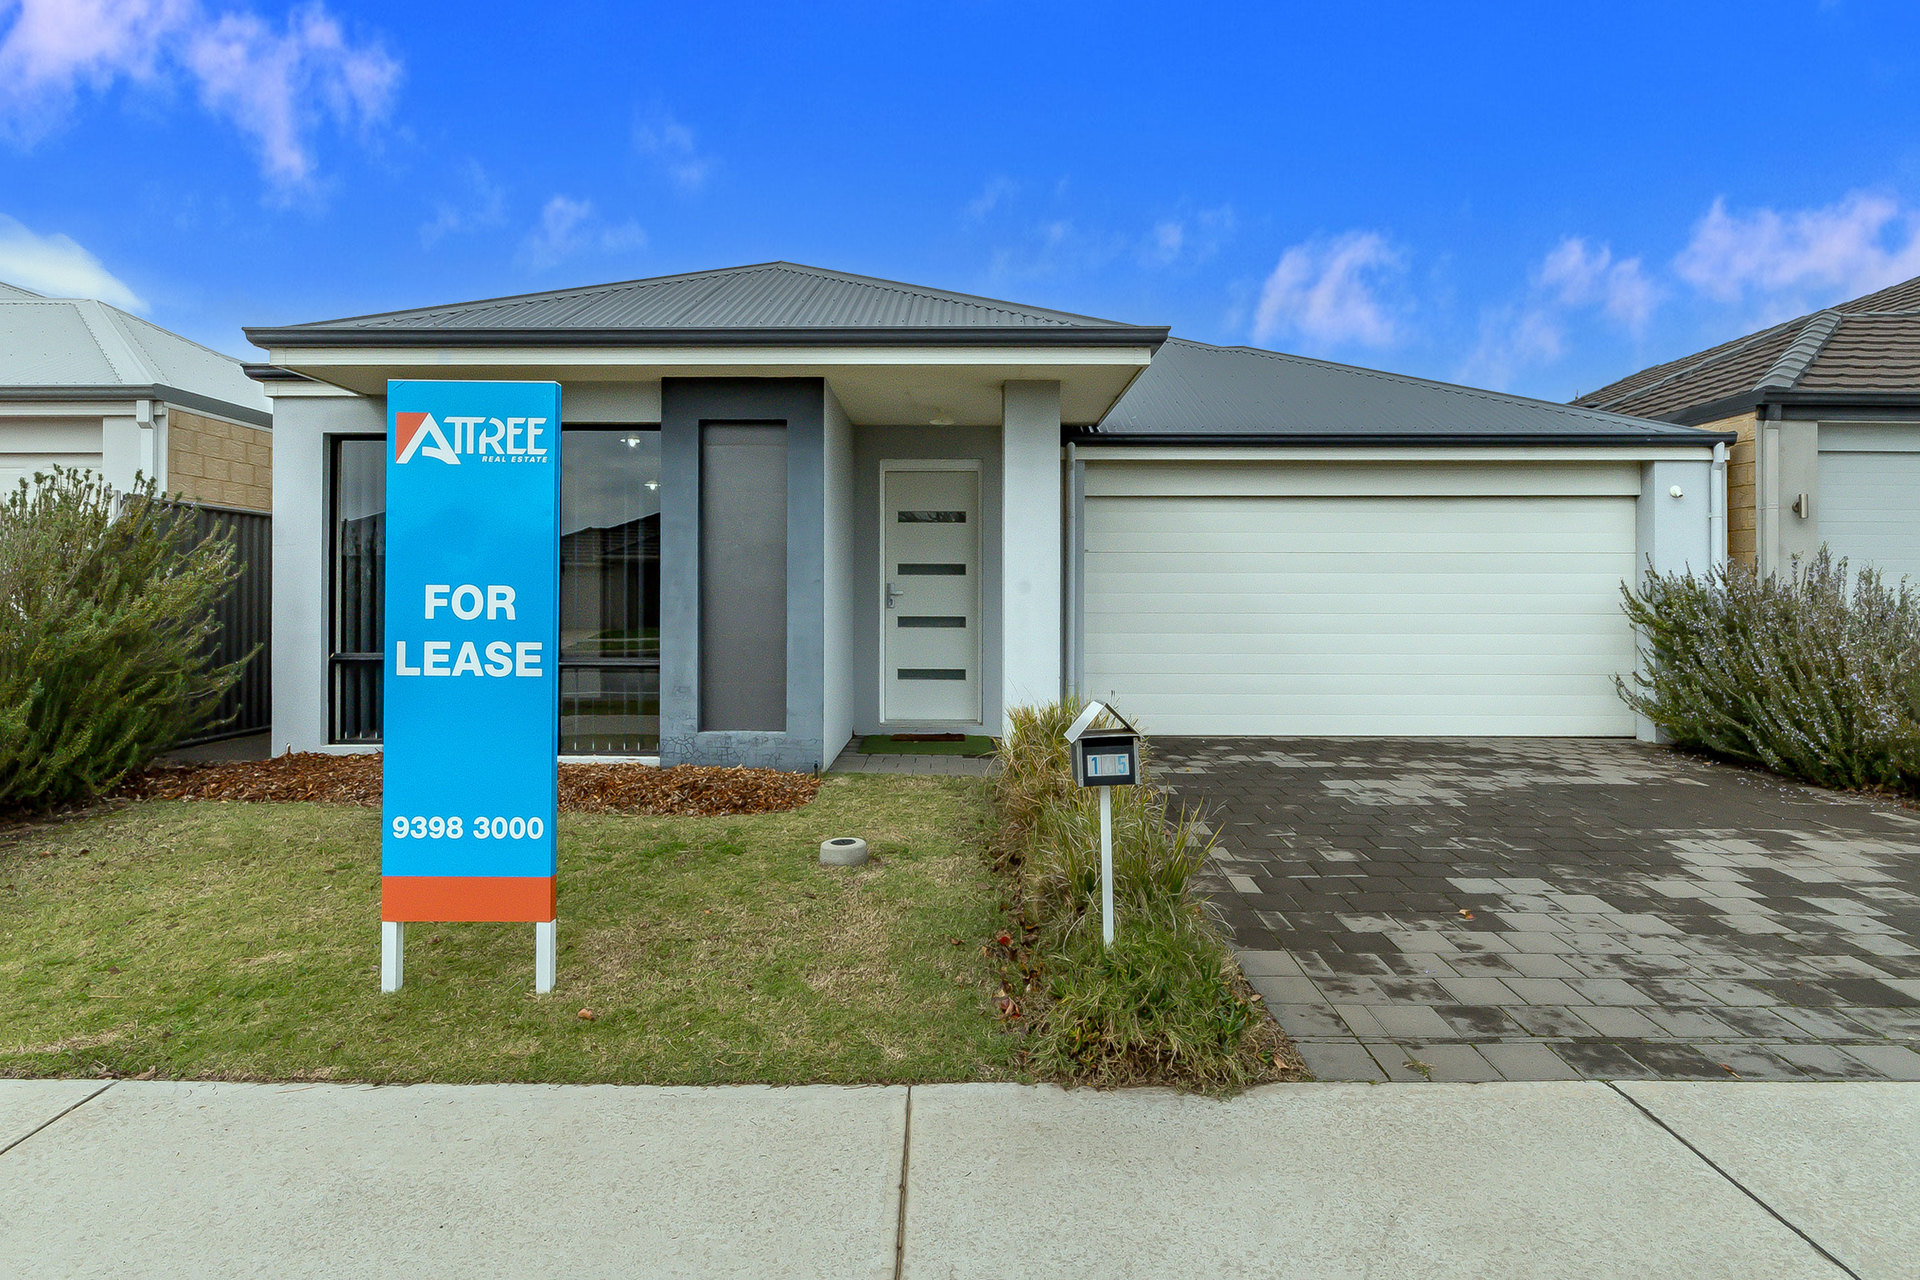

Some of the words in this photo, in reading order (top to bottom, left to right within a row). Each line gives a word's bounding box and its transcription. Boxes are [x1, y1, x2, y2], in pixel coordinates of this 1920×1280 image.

[396, 412, 548, 465] ATTREE
[481, 455, 507, 463] REAL
[511, 455, 548, 463] ESTATE
[424, 583, 517, 621] FOR
[395, 640, 543, 678] LEASE
[392, 815, 464, 840] 9398
[472, 816, 545, 840] 3000
